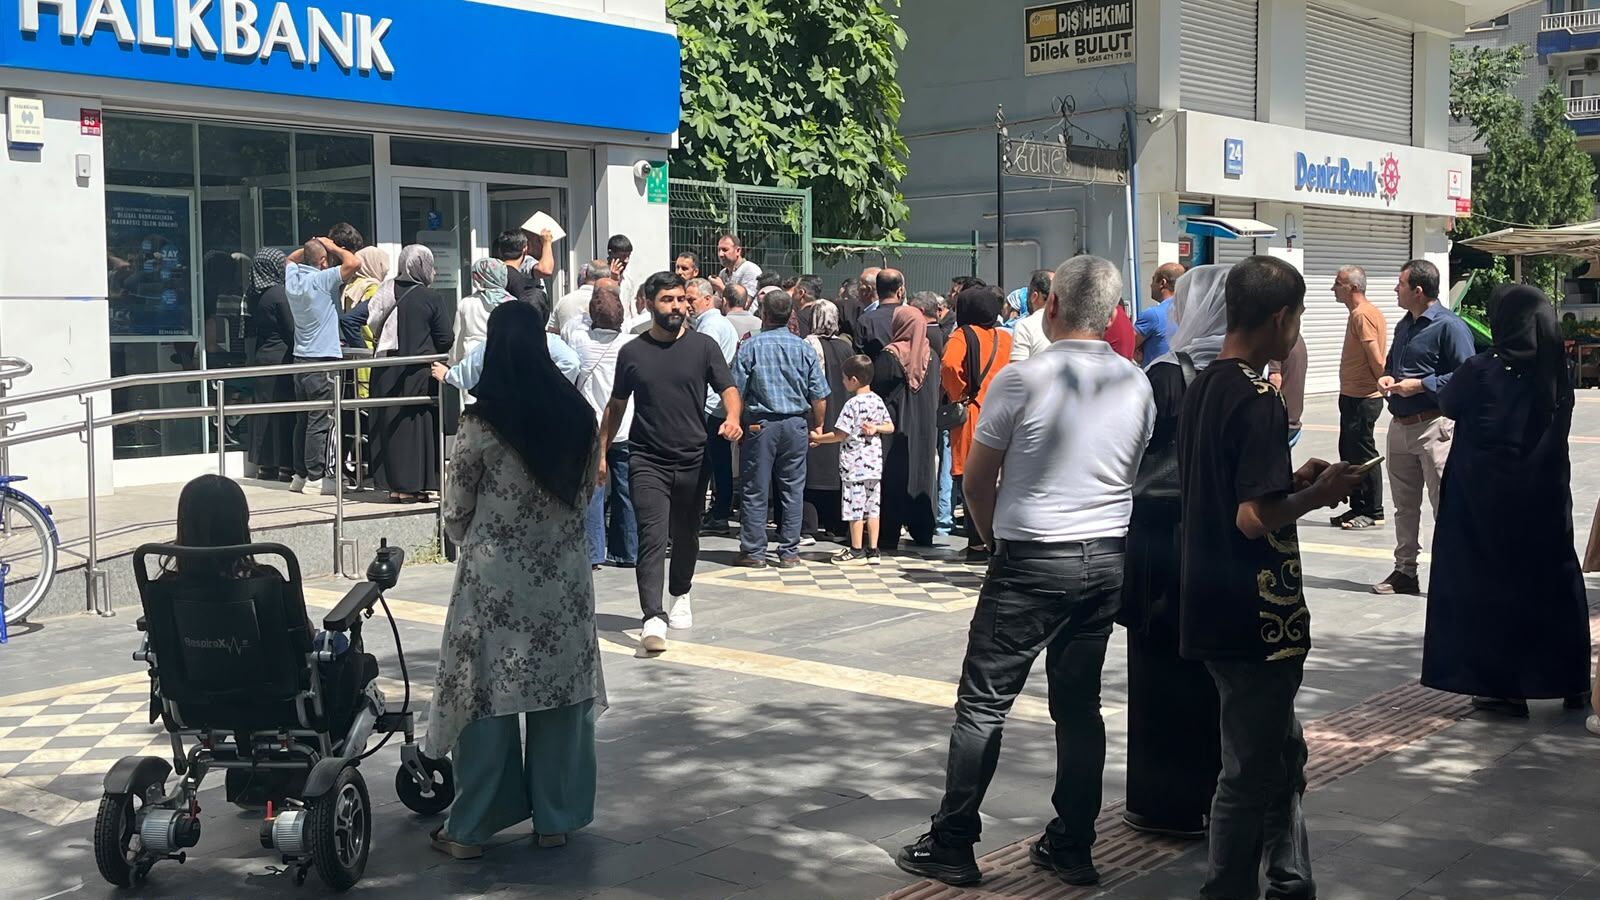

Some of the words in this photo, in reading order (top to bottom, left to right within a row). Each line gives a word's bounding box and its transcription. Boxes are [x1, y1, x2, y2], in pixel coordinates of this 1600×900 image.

[19, 0, 394, 74] HALKBANK
[1030, 41, 1070, 62] Dilek
[1075, 32, 1132, 56] BULUT
[1228, 143, 1242, 161] 24
[1296, 151, 1378, 195] DenizBank
